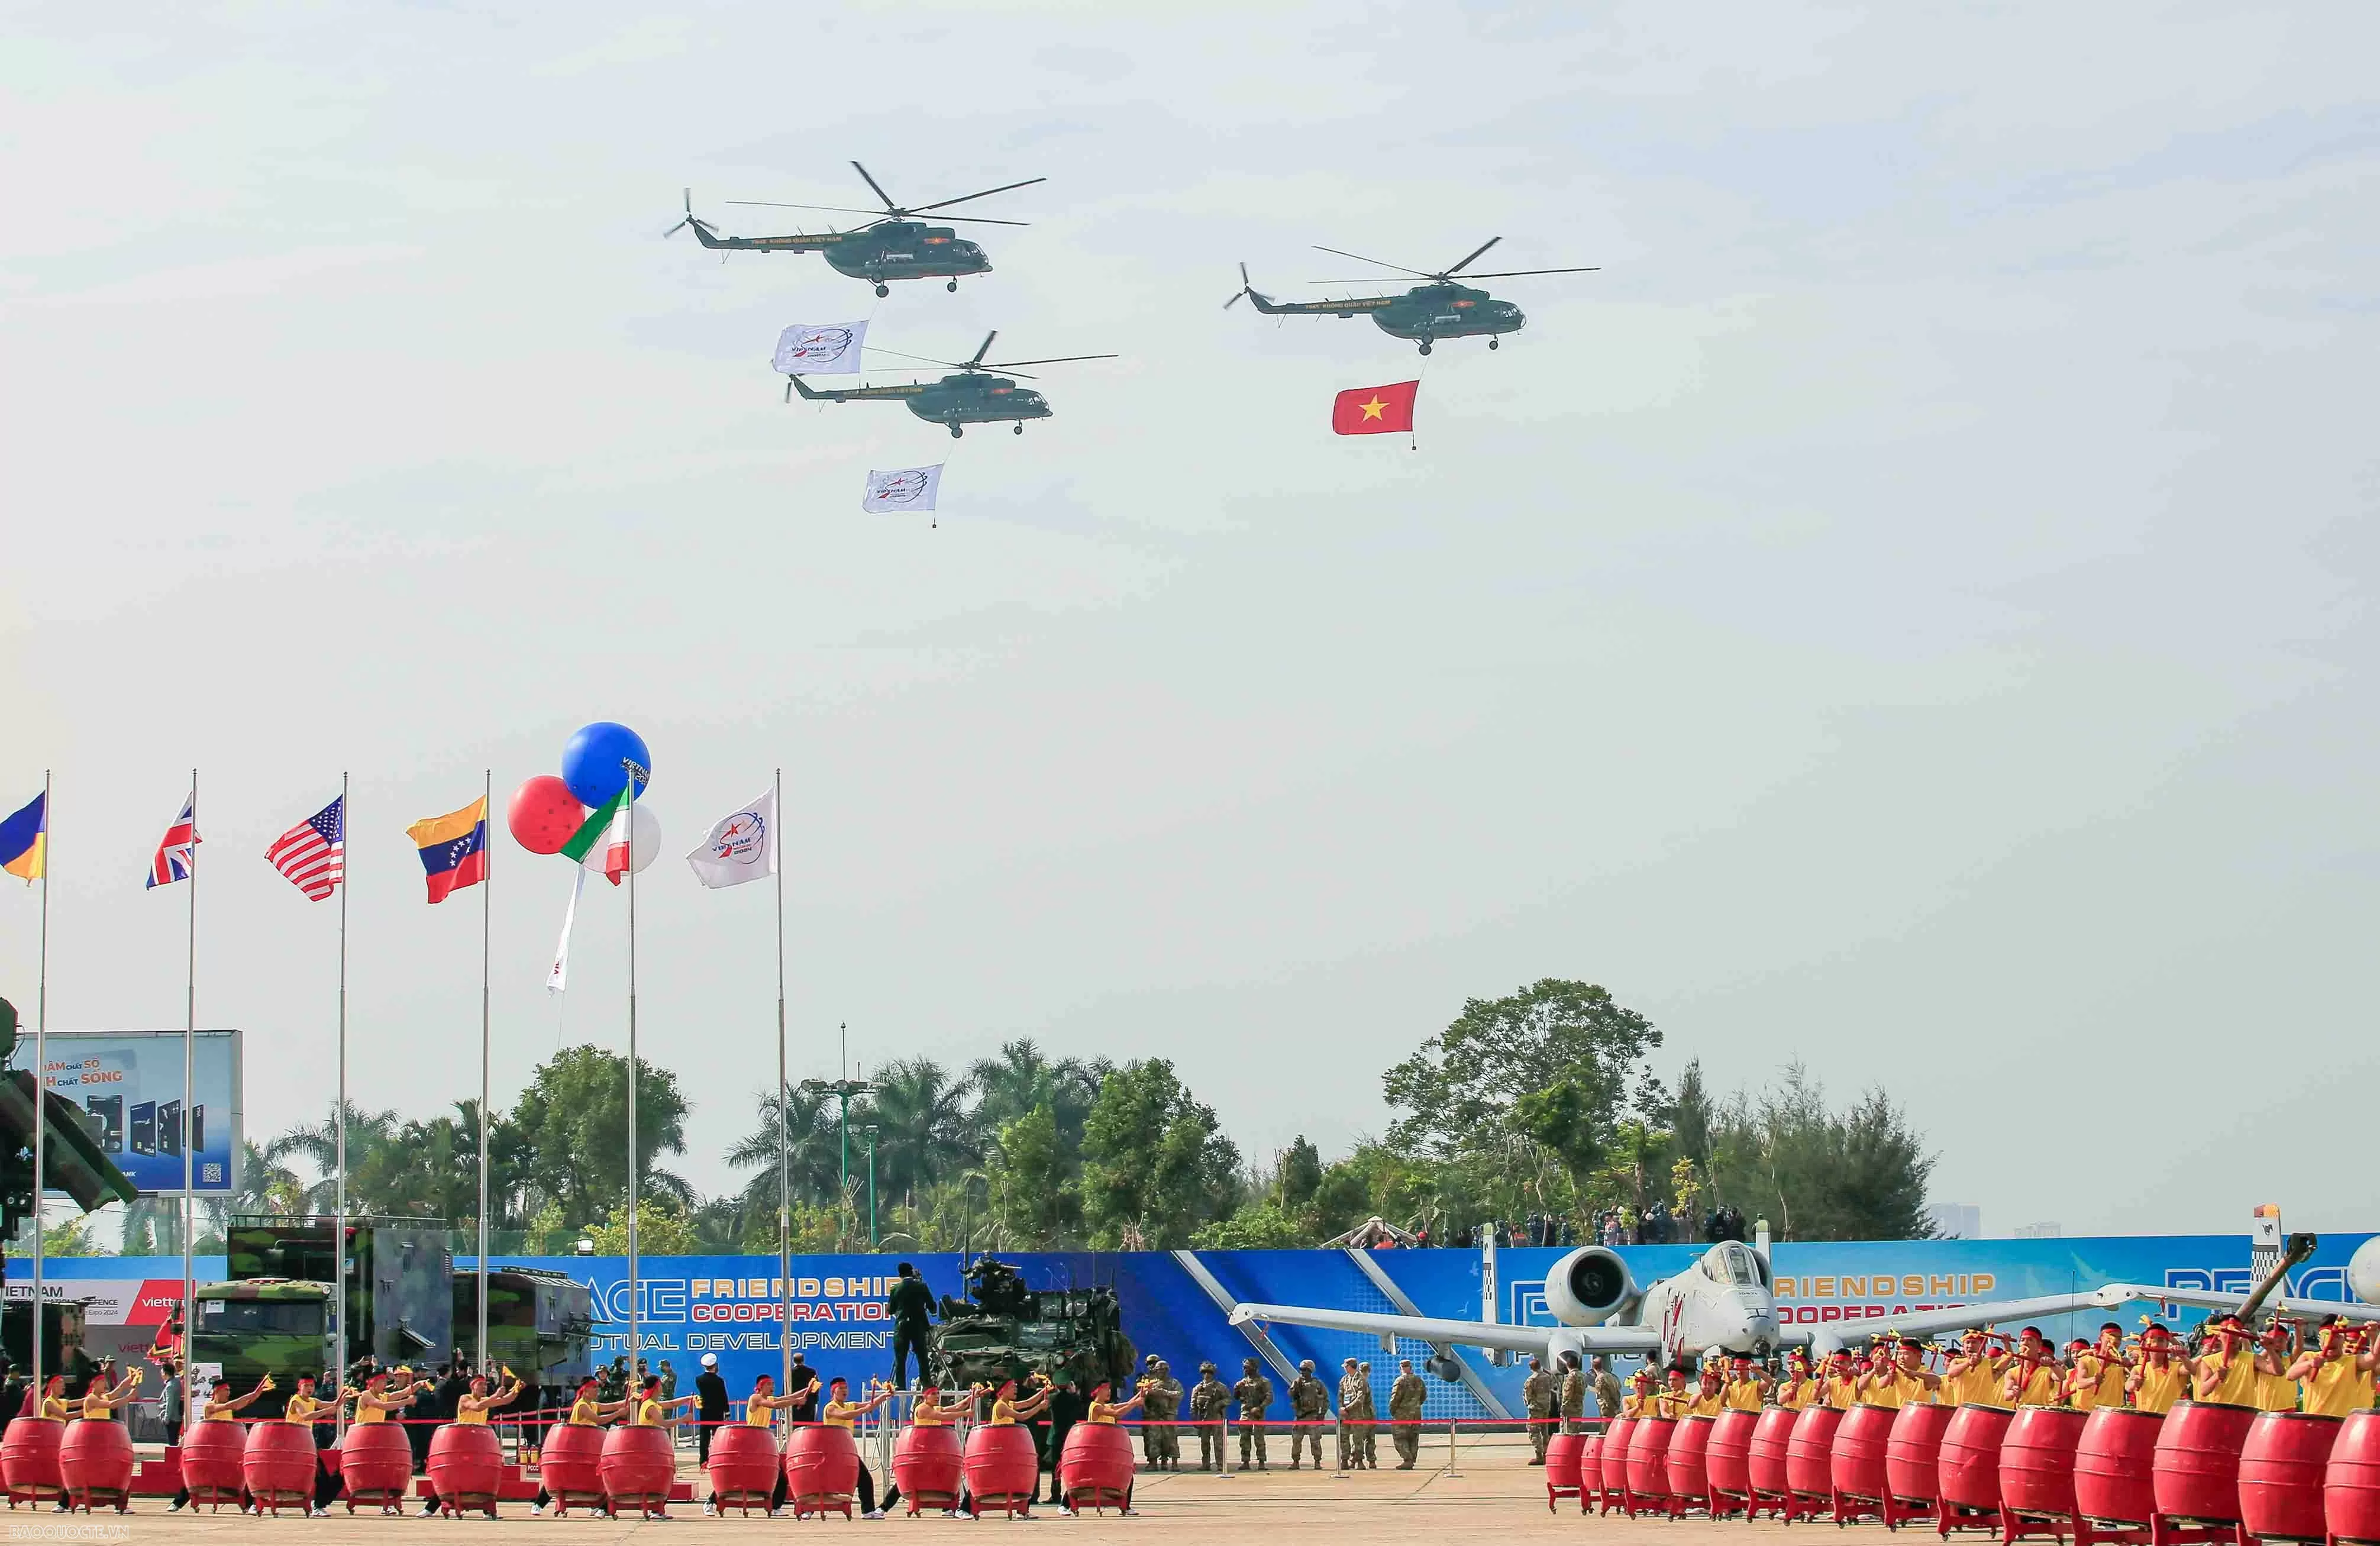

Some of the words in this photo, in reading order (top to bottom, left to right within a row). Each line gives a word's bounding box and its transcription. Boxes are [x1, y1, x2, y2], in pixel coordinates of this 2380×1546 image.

[6, 1286, 63, 1298] IETNAM
[1773, 1273, 1995, 1298] RIENDSHIP
[587, 1276, 686, 1323] ACE
[118, 1341, 149, 1353] viett
[590, 1332, 680, 1351] UTUAL
